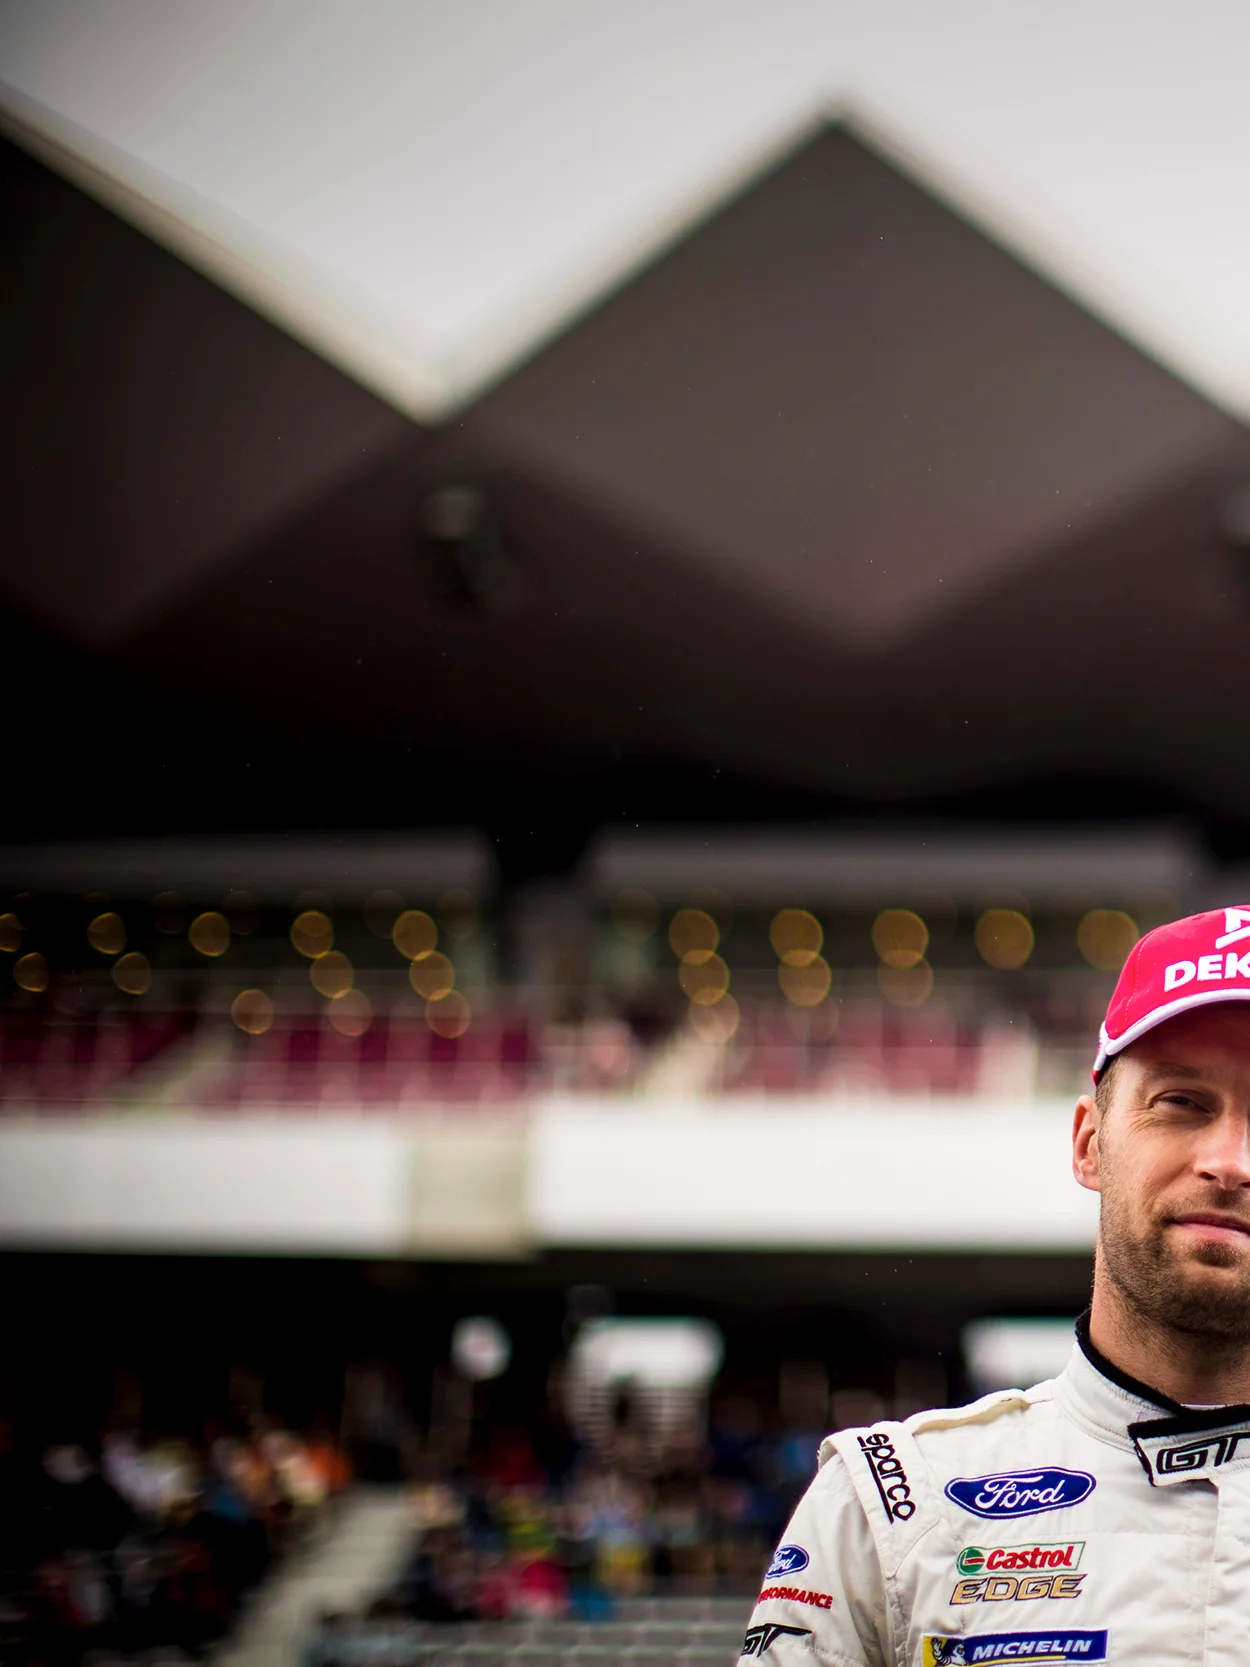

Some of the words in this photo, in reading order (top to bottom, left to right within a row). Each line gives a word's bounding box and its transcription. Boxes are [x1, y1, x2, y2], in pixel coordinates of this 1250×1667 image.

[859, 1433, 916, 1522] sparco
[974, 1475, 1066, 1508] Ford
[986, 1545, 1075, 1571] Castrol
[949, 1574, 1087, 1606] EDGE
[972, 1639, 1093, 1661] MICHELIN
